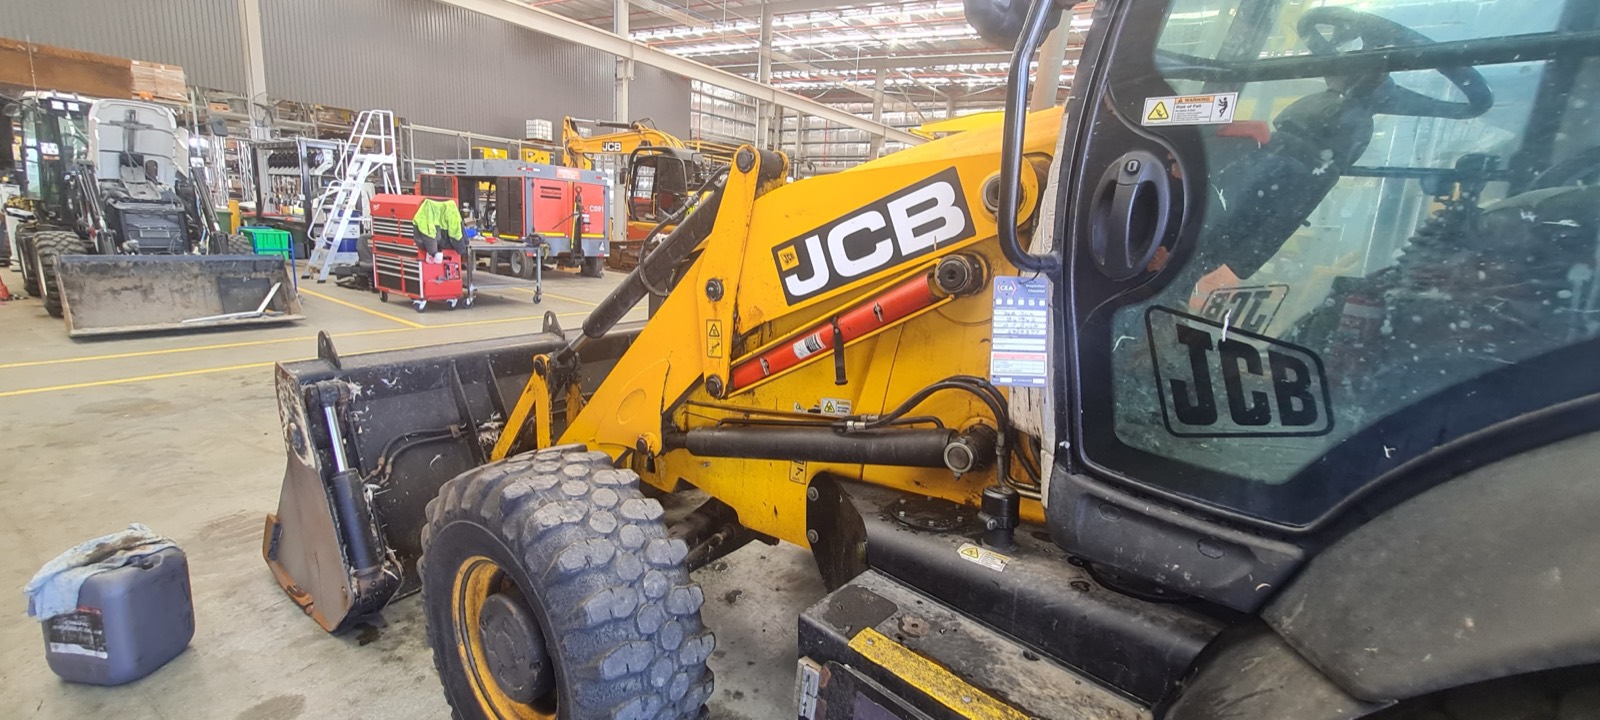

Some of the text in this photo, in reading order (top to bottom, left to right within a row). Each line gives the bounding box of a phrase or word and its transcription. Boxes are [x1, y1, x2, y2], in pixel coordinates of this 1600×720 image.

[602, 142, 621, 151] JCB
[785, 180, 966, 297] JCB
[1169, 324, 1319, 426] JCB
